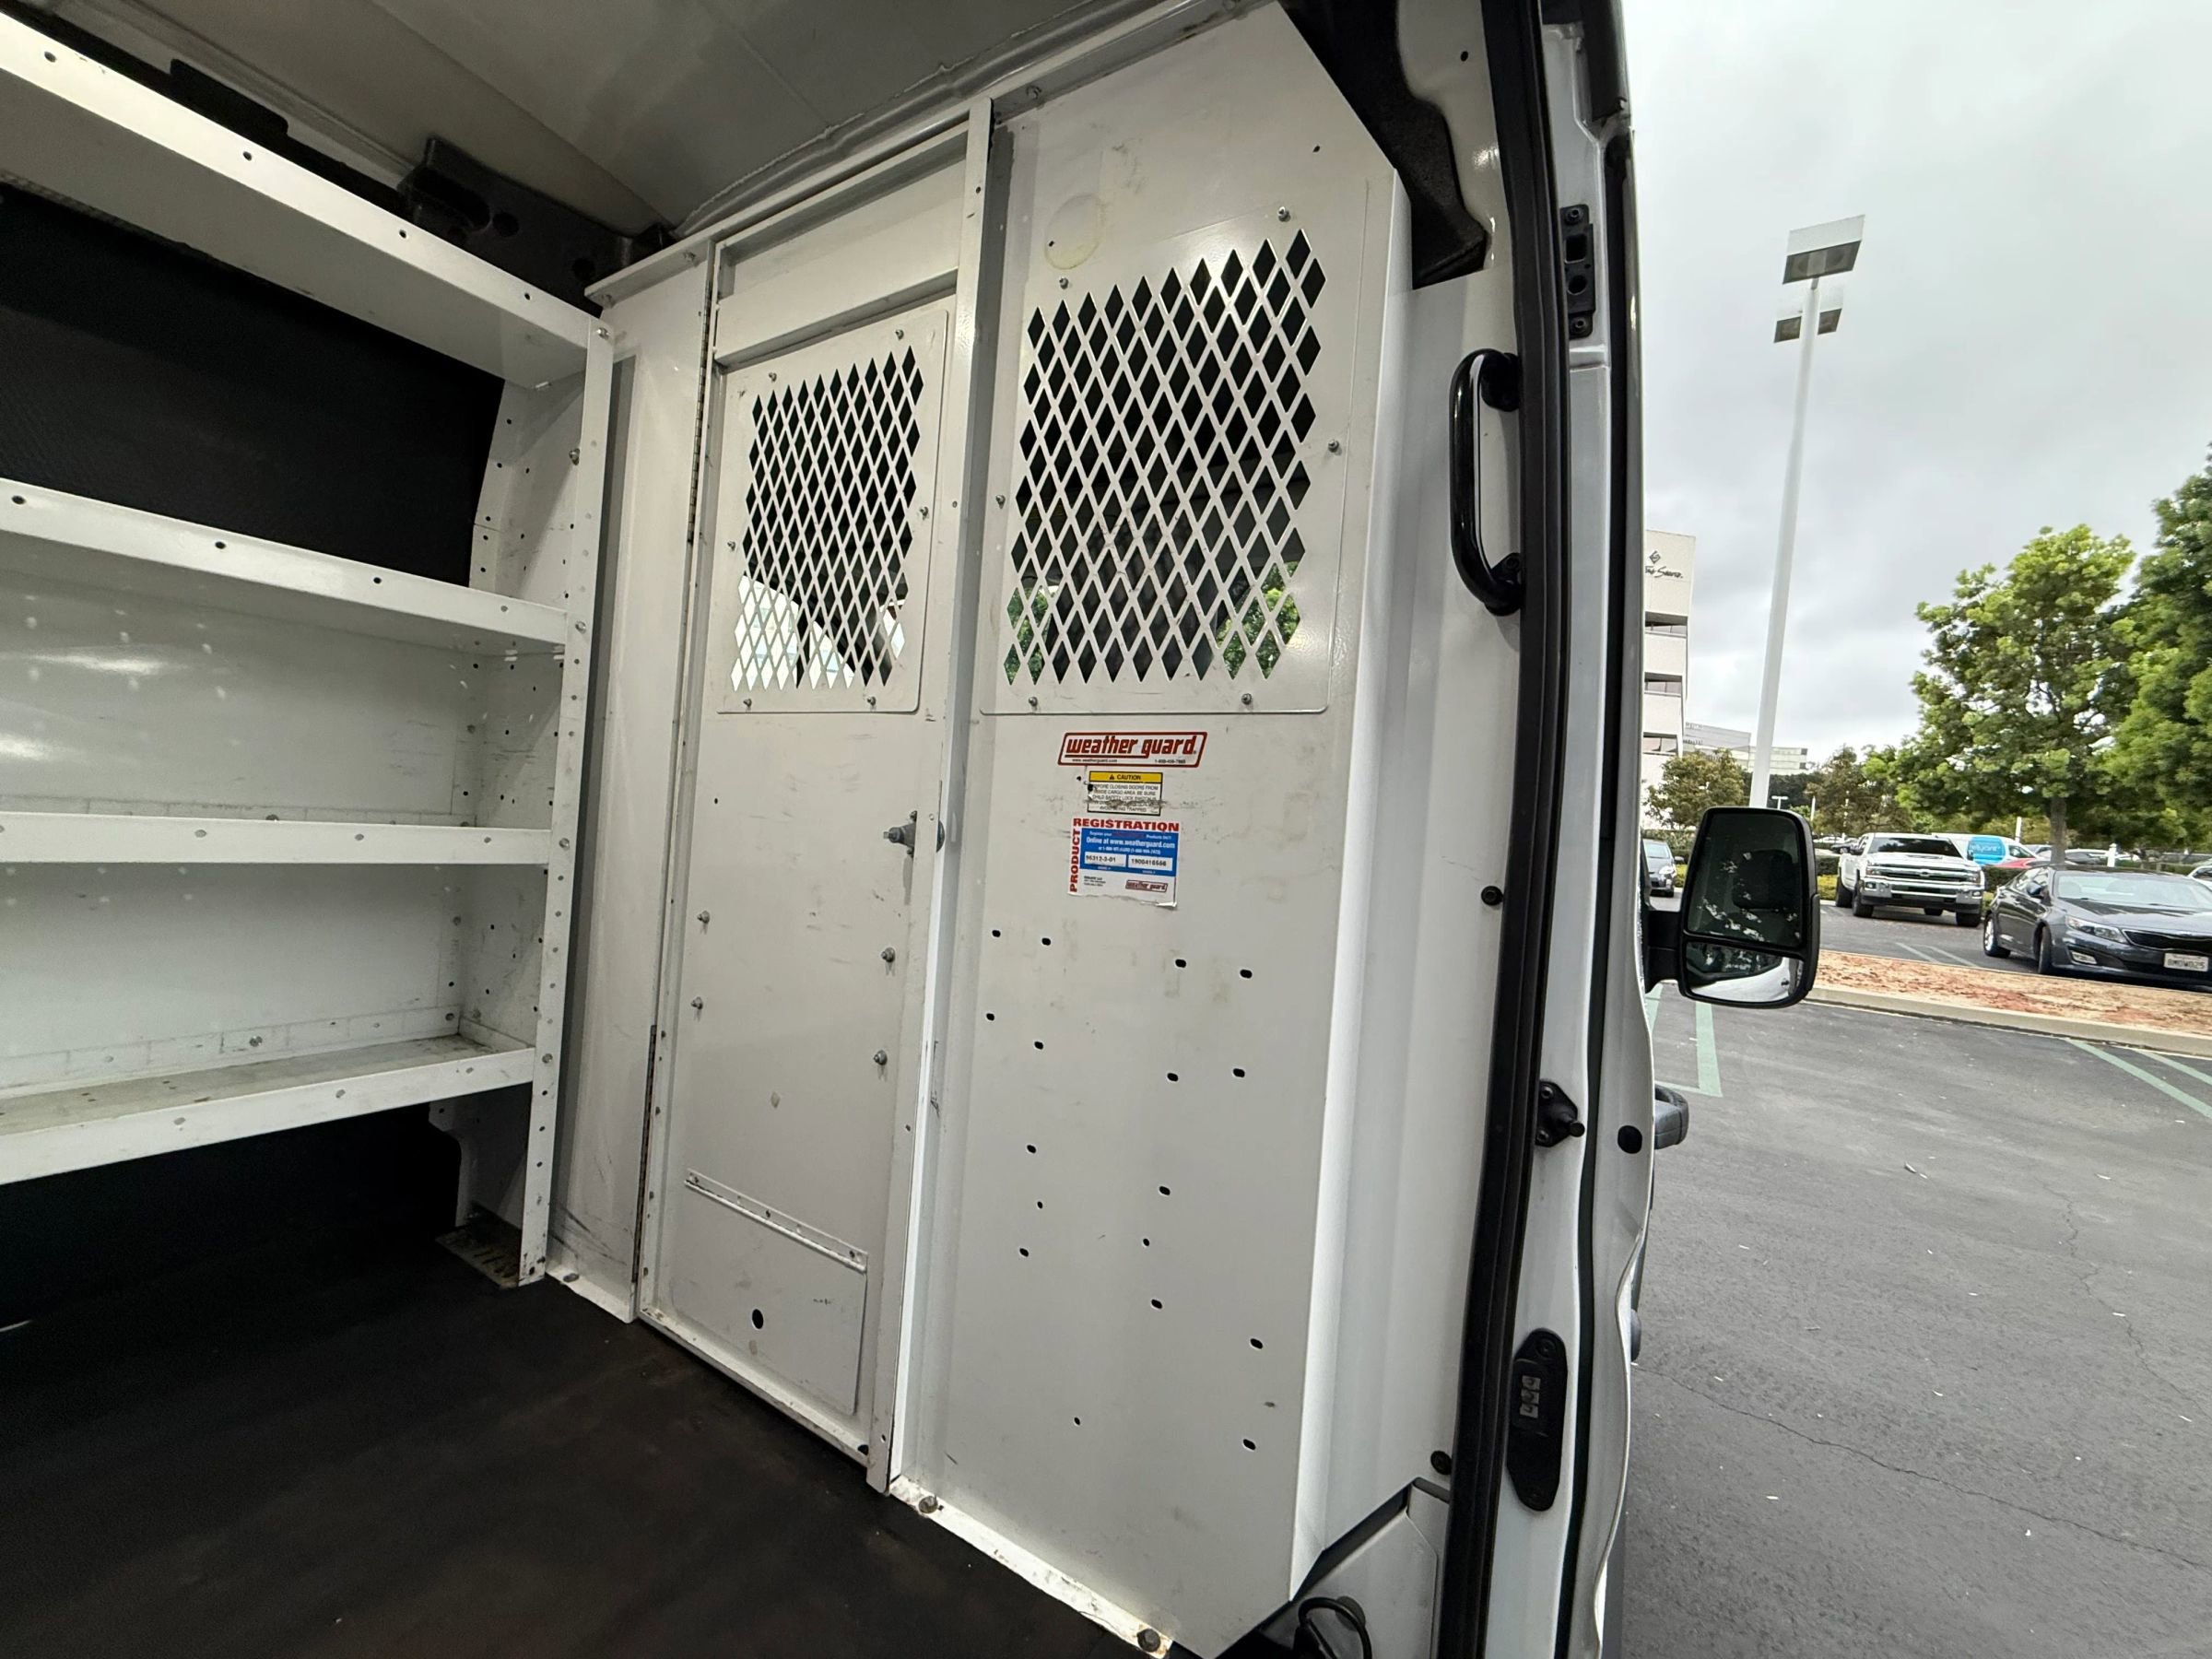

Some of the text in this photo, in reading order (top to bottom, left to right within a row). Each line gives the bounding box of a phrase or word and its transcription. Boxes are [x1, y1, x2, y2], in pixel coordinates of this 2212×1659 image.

[1066, 735, 1197, 759] weather guard
[1073, 818, 1180, 831] REGISTRATION
[1086, 836, 1102, 844] Online
[1110, 838, 1176, 848] www.weatherguard.com
[1070, 829, 1081, 892] PRODUCT
